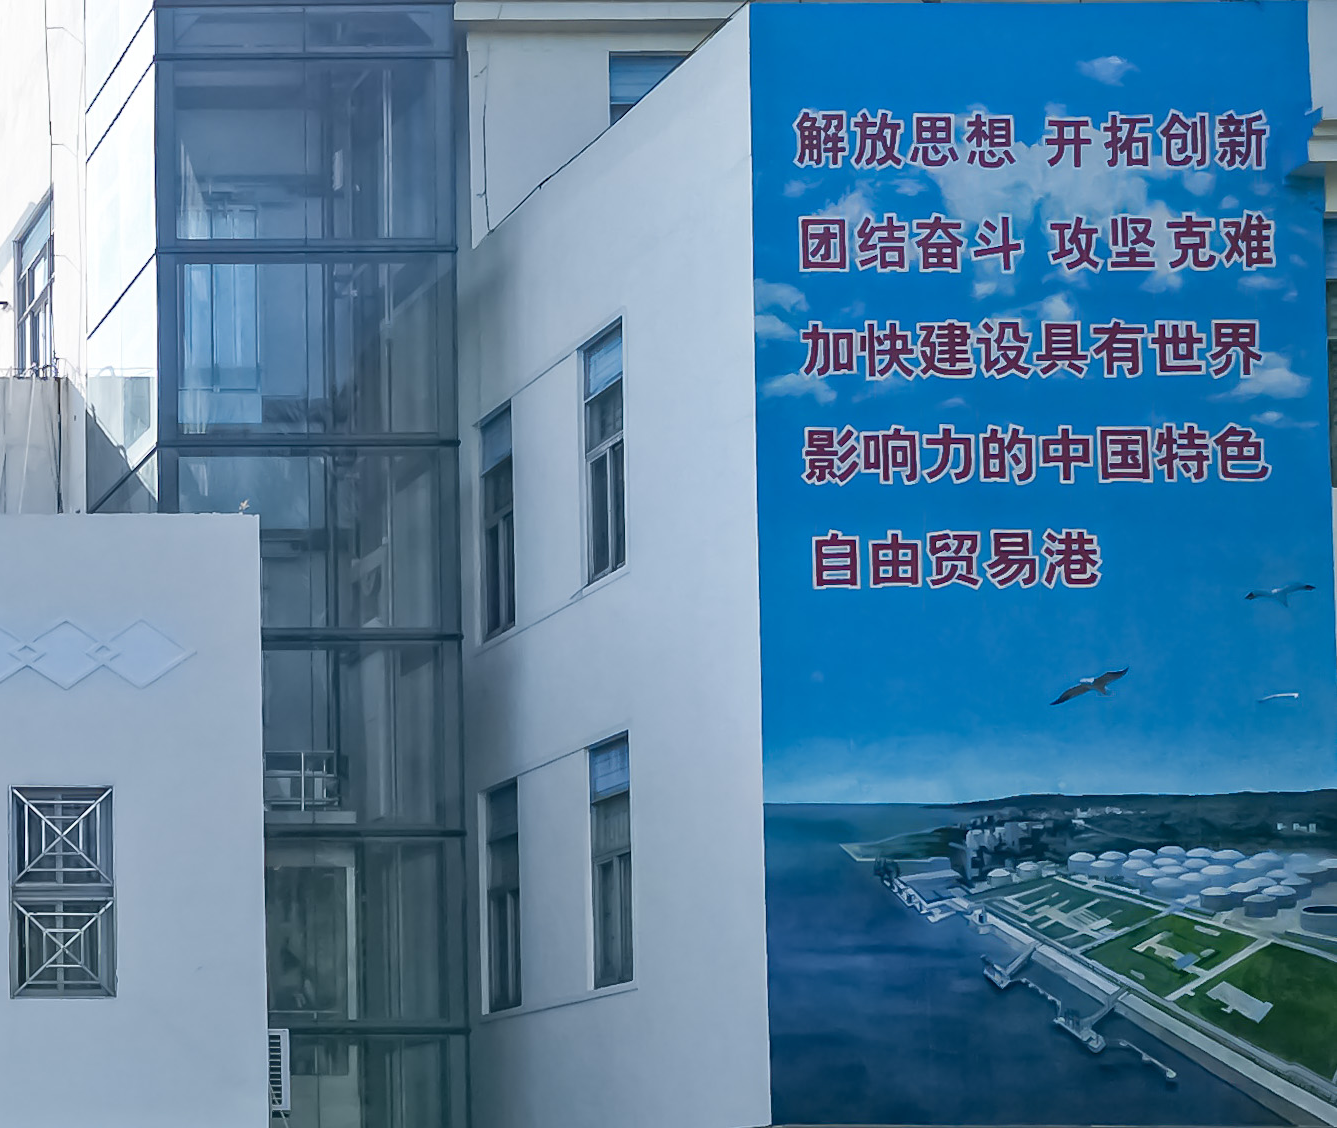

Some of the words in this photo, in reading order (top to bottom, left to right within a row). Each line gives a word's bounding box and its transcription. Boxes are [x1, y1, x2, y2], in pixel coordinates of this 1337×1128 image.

[793, 109, 1017, 170] 解放思想
[1043, 109, 1270, 170] 开拓创新
[798, 212, 1025, 273] 团结奋斗
[1047, 210, 1276, 273] 攻坚克难
[800, 318, 1263, 380] 加快建设具有世界
[801, 424, 1272, 485] 影响力的中国特色
[811, 529, 1103, 589] 自由贸易港
